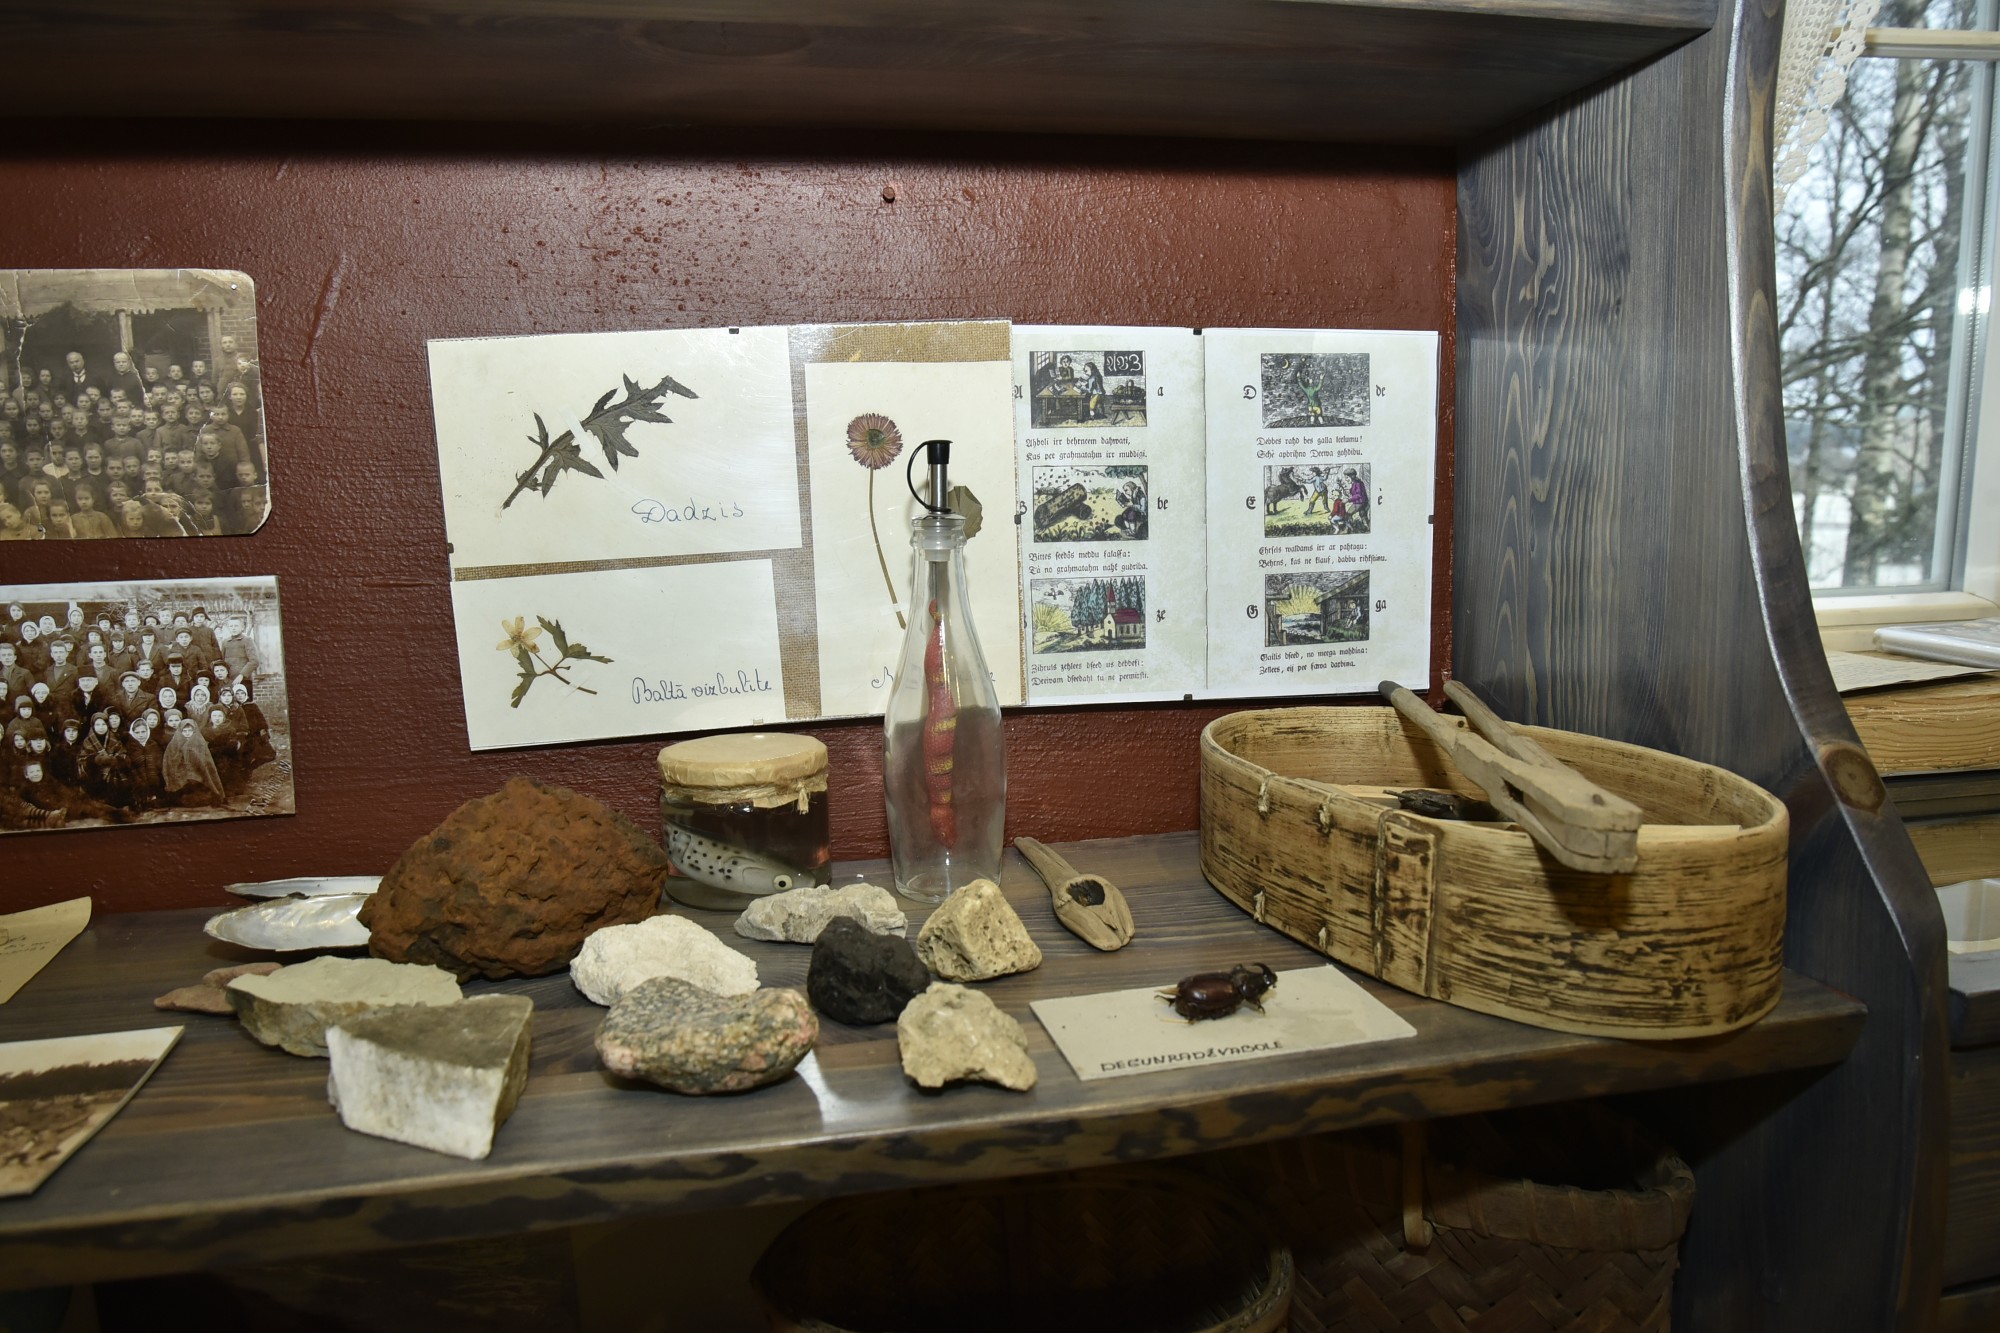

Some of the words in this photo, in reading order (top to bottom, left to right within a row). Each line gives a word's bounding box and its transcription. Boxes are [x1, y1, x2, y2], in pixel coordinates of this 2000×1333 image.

[1157, 385, 1164, 397] a
[631, 497, 744, 523] Dadzis
[632, 677, 688, 704] Baltā
